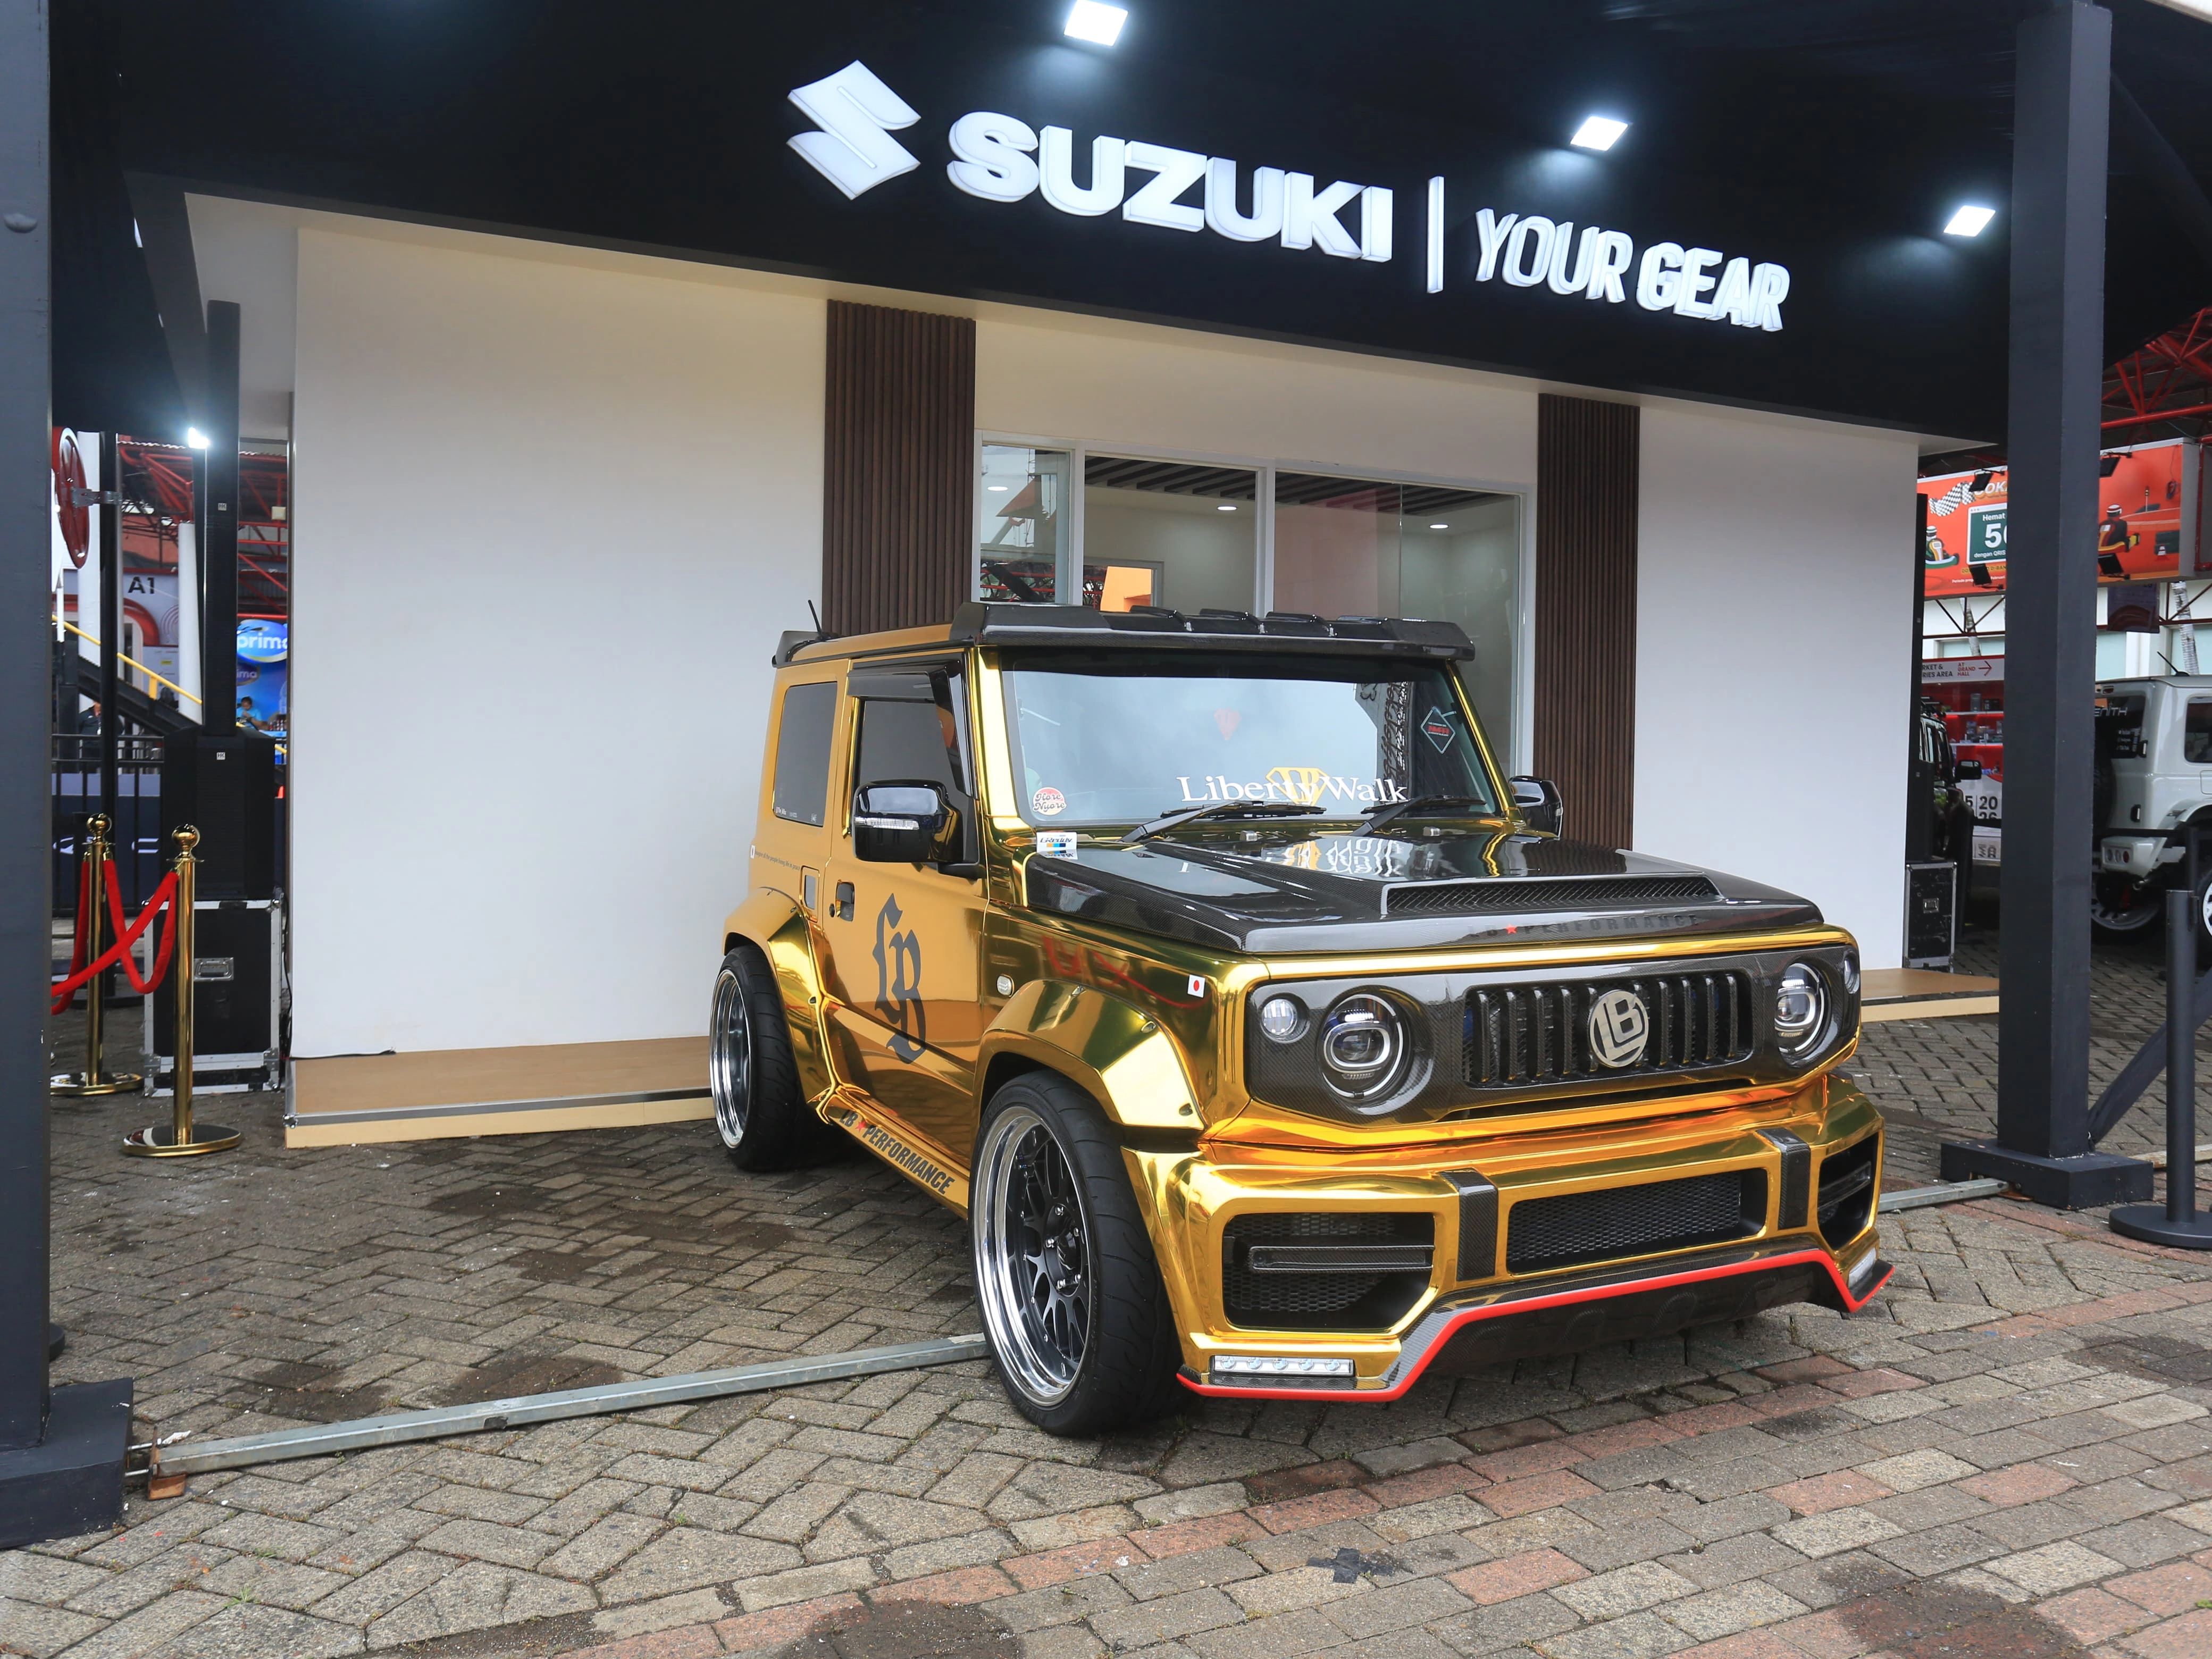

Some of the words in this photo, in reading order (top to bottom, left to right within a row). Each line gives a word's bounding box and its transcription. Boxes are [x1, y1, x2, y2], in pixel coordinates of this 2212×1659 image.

[946, 111, 1393, 263] SUZUKI
[1476, 208, 1633, 303] YOUR
[1636, 242, 1790, 331] GEAR
[1982, 513, 2005, 521] Hemat
[128, 576, 155, 594] A1
[1176, 775, 1317, 805] Liberty
[1319, 776, 1408, 802] Walk
[1979, 796, 1998, 810] 20
[1525, 914, 1699, 934] PERFORMANCE
[862, 1125, 956, 1195] PERFORMANCE
